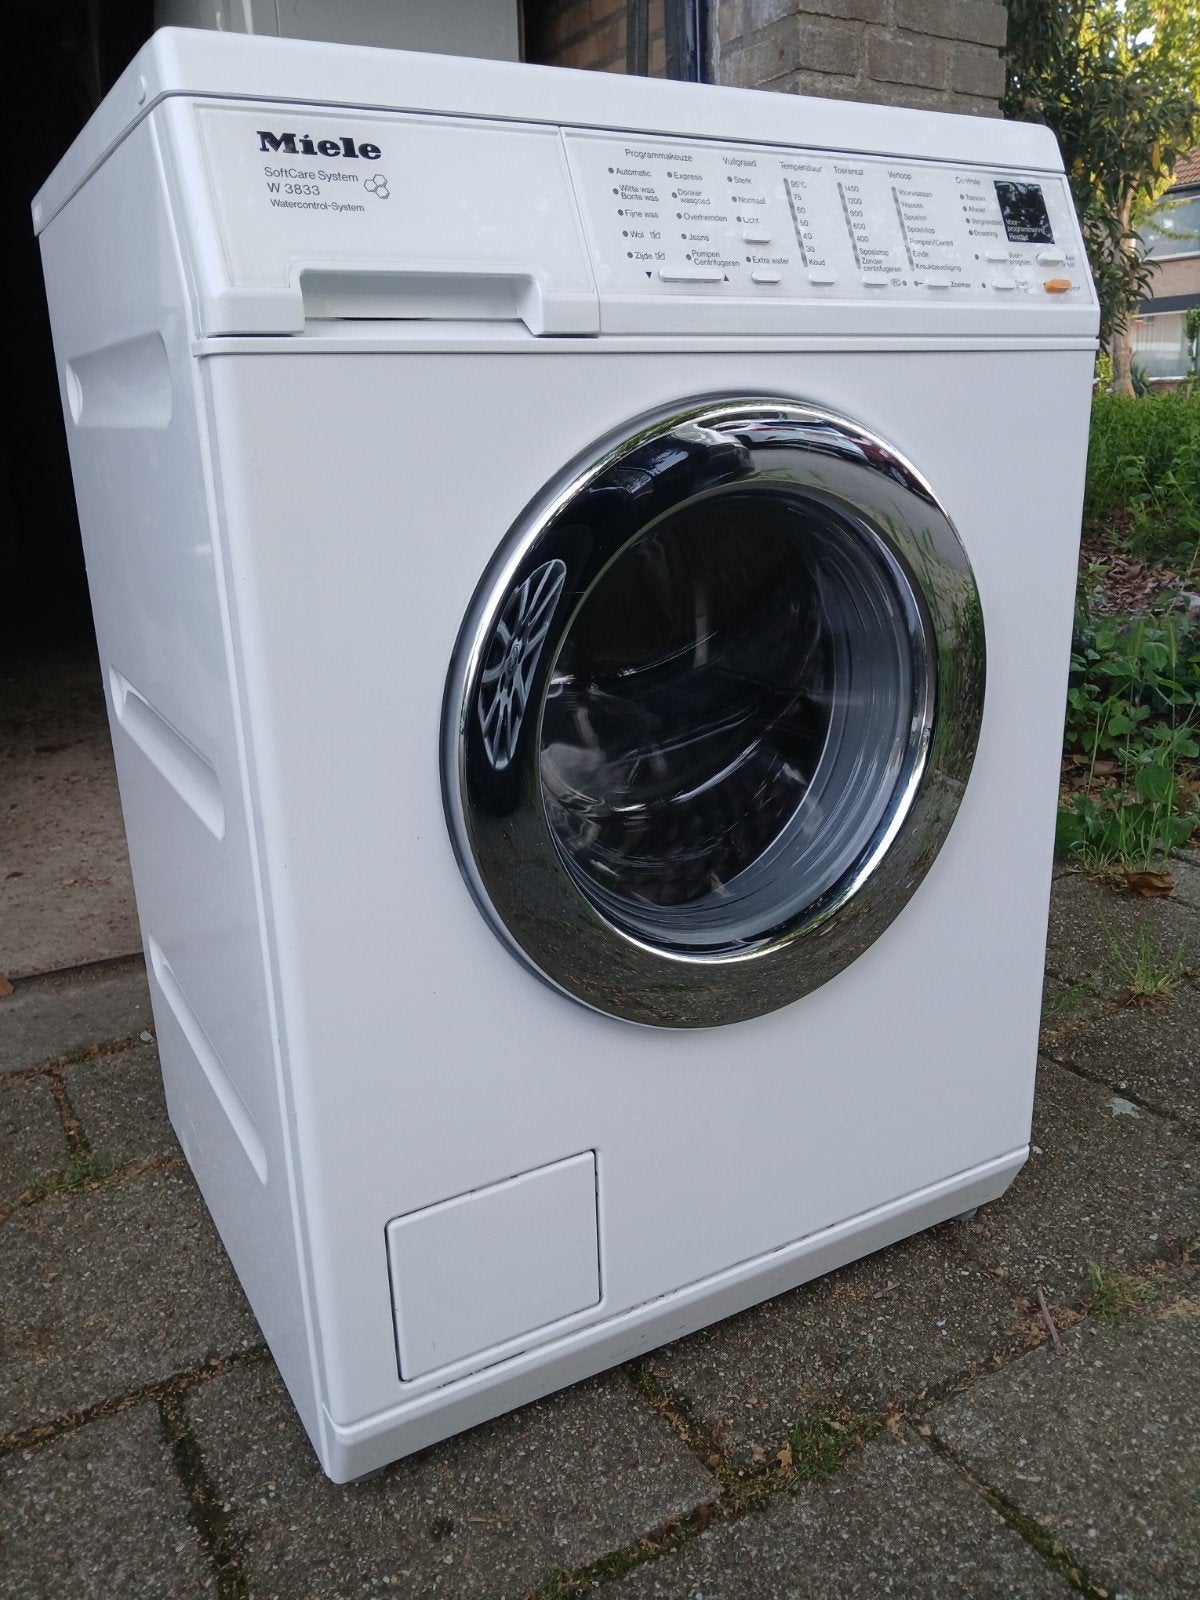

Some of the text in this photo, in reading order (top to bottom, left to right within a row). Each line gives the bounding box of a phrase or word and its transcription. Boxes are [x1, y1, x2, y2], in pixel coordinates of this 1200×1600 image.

[257, 131, 381, 160] Miele
[624, 148, 692, 162] Programmakeuze
[722, 157, 756, 167] Vuilgraad
[779, 162, 822, 172] Temperatuur
[833, 166, 864, 176] Toerental
[264, 166, 358, 182] SoftCare System
[616, 168, 652, 177] Automatic
[674, 172, 702, 180] Express
[888, 171, 912, 180] Verloop
[267, 182, 320, 196] W 3833
[620, 184, 639, 192] Witte
[678, 188, 702, 196] Donker
[620, 192, 643, 200] Bonte
[898, 188, 932, 198] Voorwassen
[738, 196, 766, 204] Normaal
[270, 198, 364, 212] Watercontrol-System
[624, 209, 642, 218] Fijne
[684, 212, 728, 222] Overhemden
[906, 226, 936, 234] Spoelstop
[688, 234, 710, 242] Jeans
[634, 252, 652, 260] Zijde
[692, 250, 720, 258] Pompen
[860, 248, 889, 256] Spoelstop
[694, 258, 740, 268] Centrifugeren
[864, 265, 902, 273] centrifugeren
